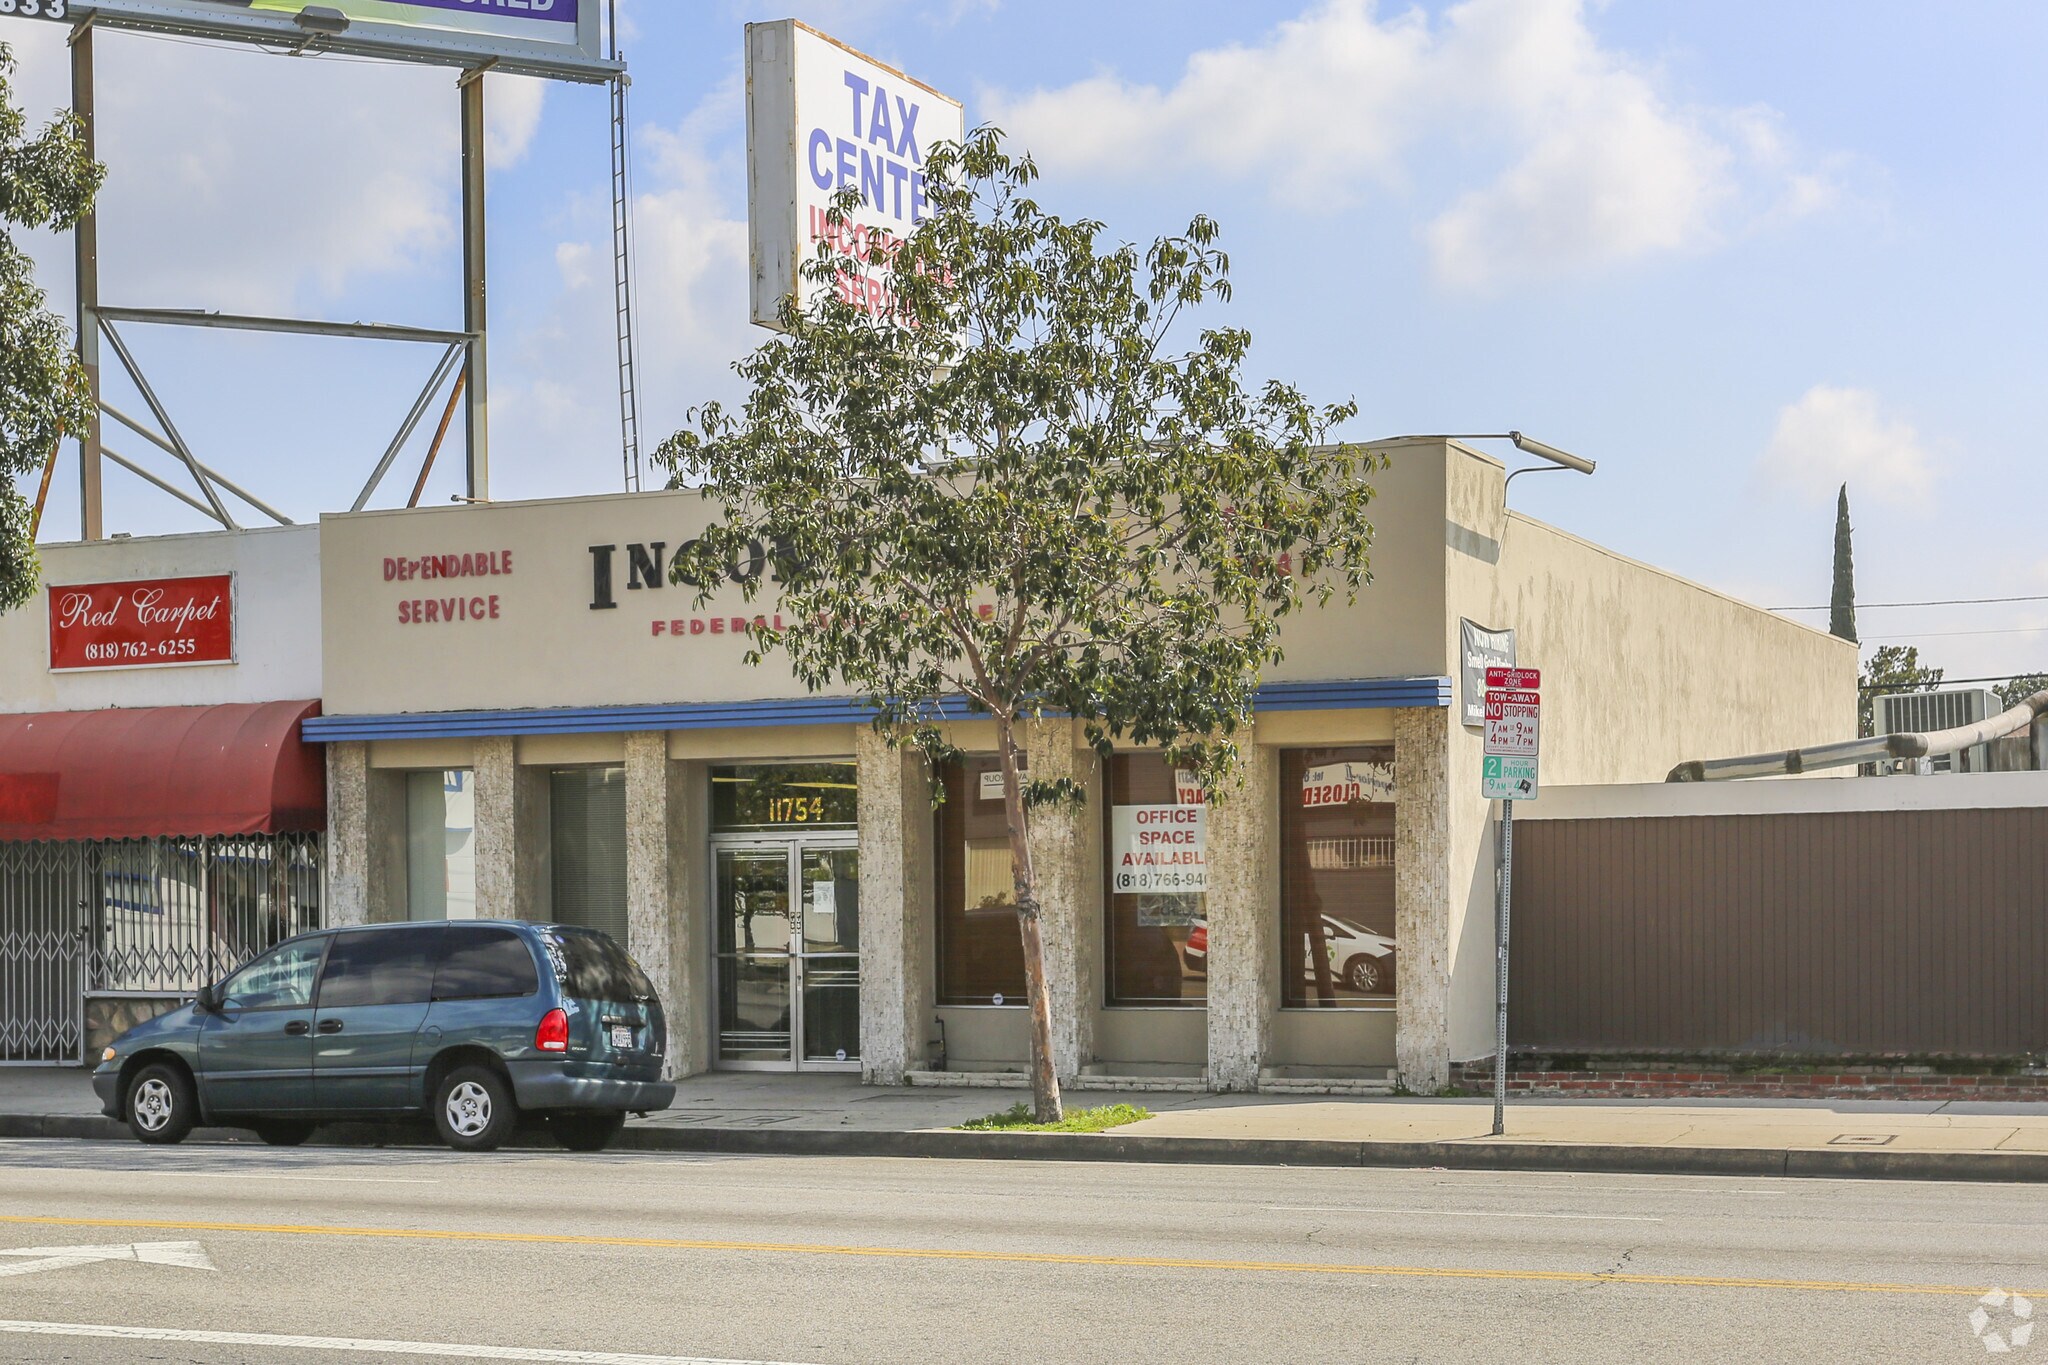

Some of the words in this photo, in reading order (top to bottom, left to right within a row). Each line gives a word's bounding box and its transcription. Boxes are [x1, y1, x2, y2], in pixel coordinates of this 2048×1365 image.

[844, 70, 921, 165] TAX
[60, 593, 123, 629] Red
[132, 588, 221, 633] Carpet
[398, 595, 499, 624] SERVICE
[652, 614, 786, 636] FEDERAL
[85, 642, 119, 661] (818)
[1488, 671, 1538, 679] ANTI-GRIDLOCK
[1488, 693, 1536, 703] TOW-AWAY
[1486, 702, 1501, 717] NO
[1504, 705, 1537, 718] STOPPING
[1490, 721, 1497, 732] 7
[1498, 725, 1508, 733] AM
[1516, 722, 1522, 733] 9
[1490, 733, 1497, 744] 4
[1498, 737, 1508, 745] PM
[1516, 734, 1522, 745] 7
[1487, 758, 1497, 776] 2
[1504, 766, 1535, 779] PARKING
[1489, 779, 1495, 789] 9
[769, 797, 824, 822] 11754
[1136, 810, 1197, 824] OFFICE
[1139, 830, 1195, 845] SPACE
[1116, 872, 1207, 890] (818)766-94
